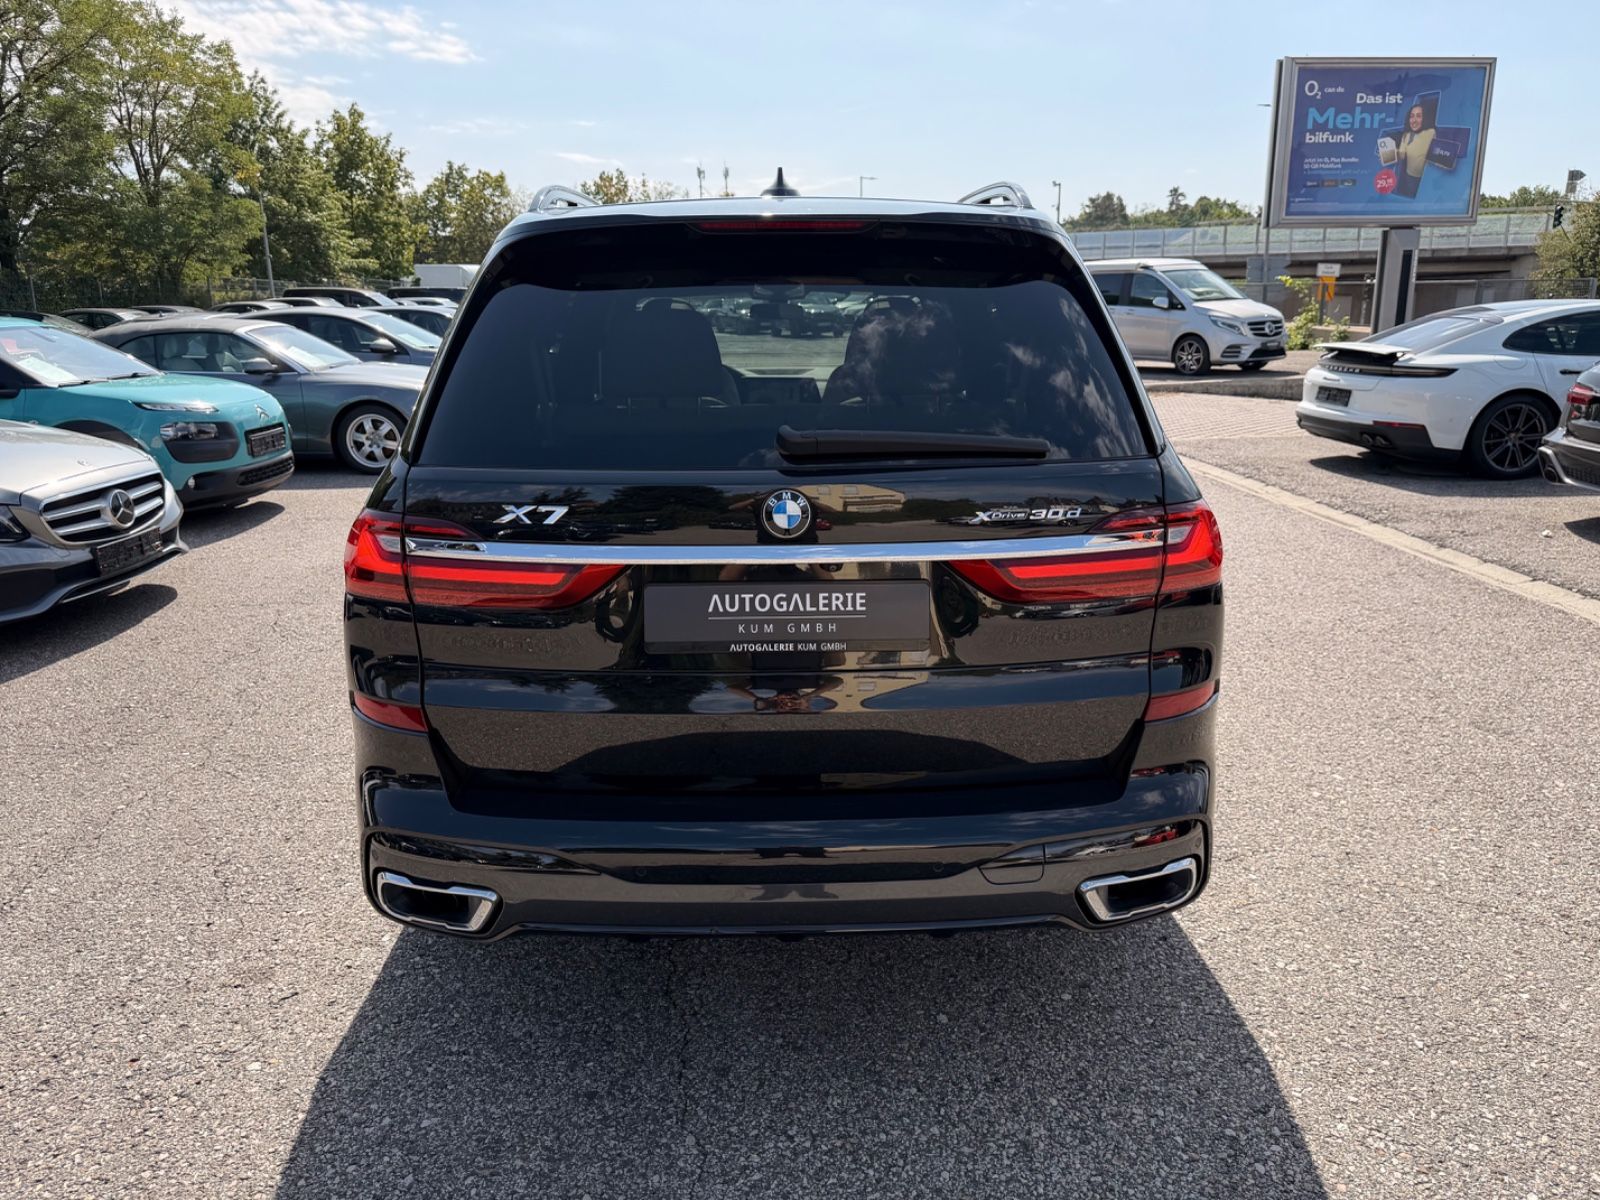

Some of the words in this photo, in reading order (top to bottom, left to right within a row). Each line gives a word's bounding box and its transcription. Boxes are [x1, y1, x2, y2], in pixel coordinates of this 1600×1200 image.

[1356, 92, 1383, 104] Das
[1385, 92, 1403, 104] ist
[1306, 106, 1395, 130] Mehr-
[1305, 131, 1354, 143] bilfunk
[768, 491, 807, 507] BMW
[493, 504, 569, 524] X7
[707, 592, 867, 613] AUTOGALERIE
[738, 623, 774, 634] KUM
[787, 622, 837, 634] GMBH
[729, 642, 794, 653] AUTOGALERIE
[797, 642, 817, 652] KUM
[820, 641, 847, 652] GMBH
